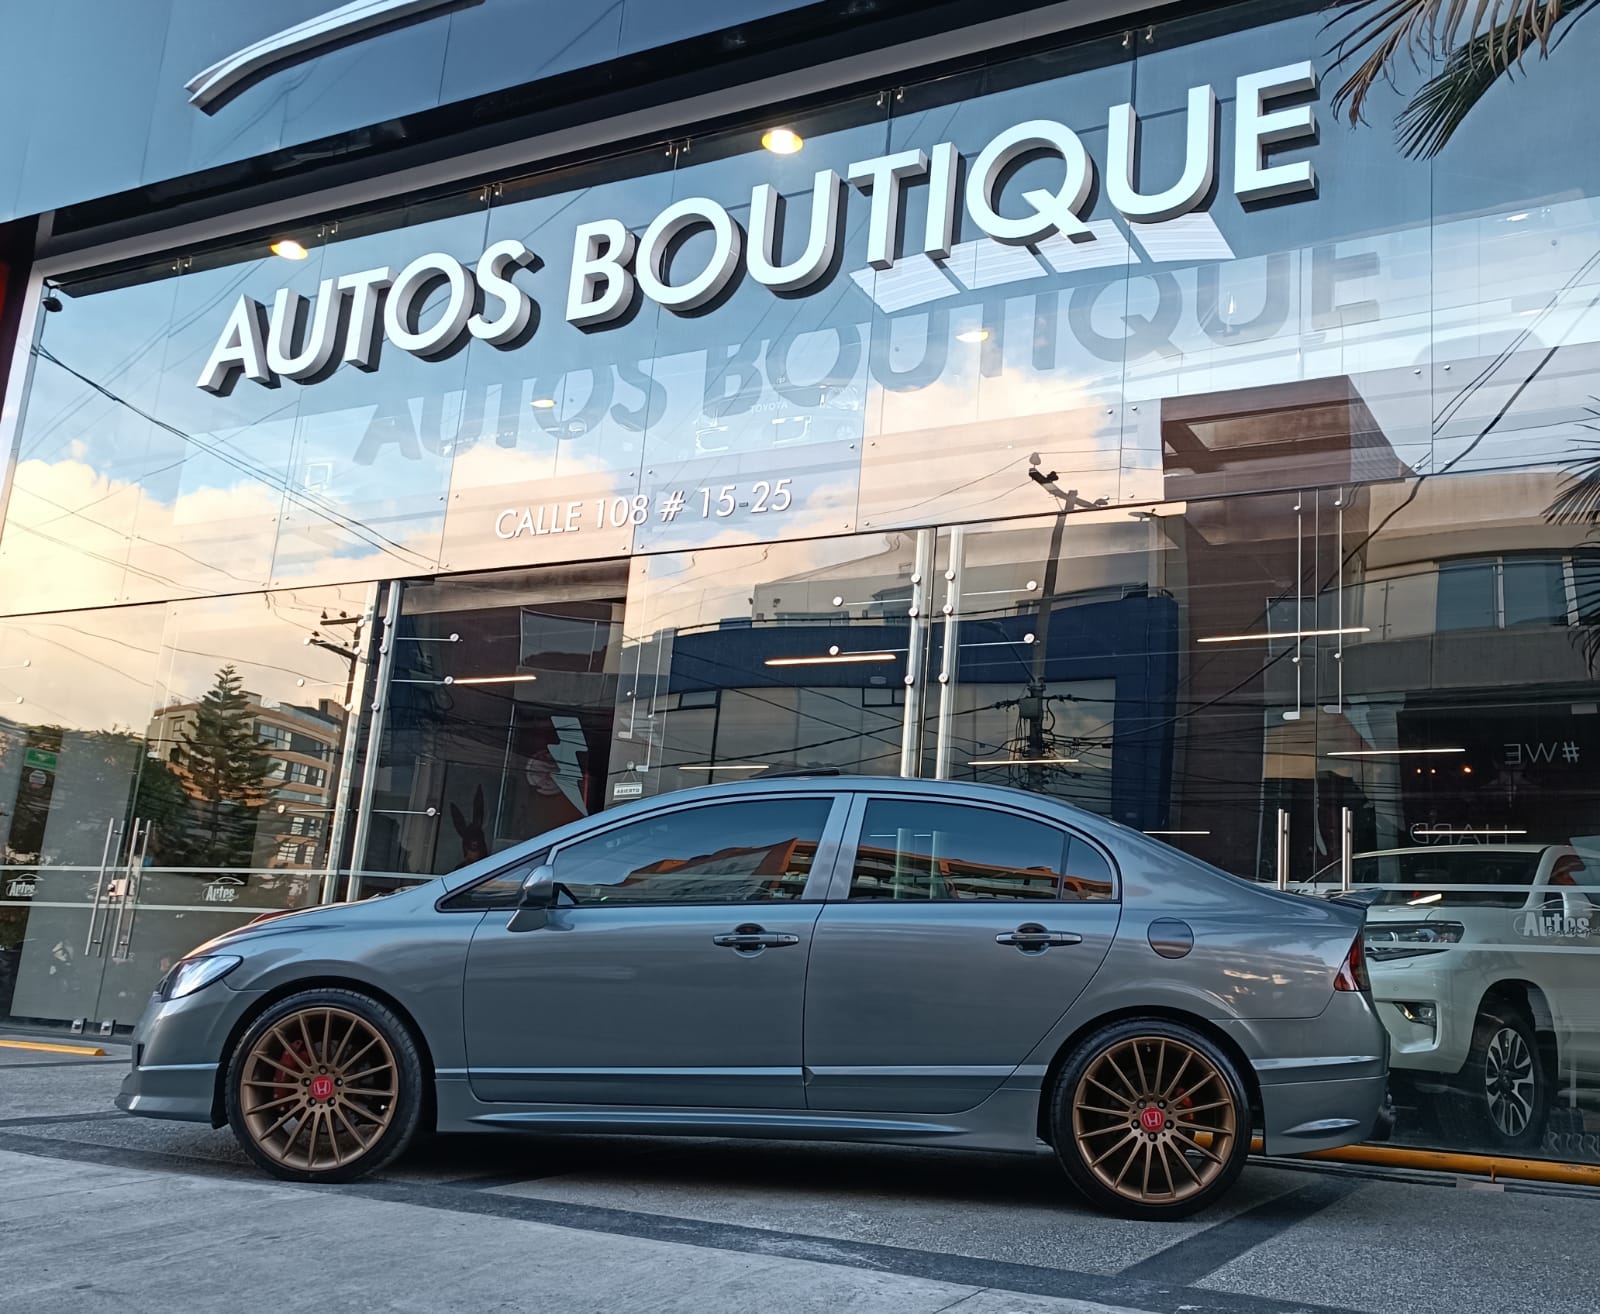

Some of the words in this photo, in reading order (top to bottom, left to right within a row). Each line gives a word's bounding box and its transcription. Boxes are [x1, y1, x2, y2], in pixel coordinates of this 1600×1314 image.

[197, 239, 543, 397] AUTOS
[565, 60, 1320, 333] BOUTIQUE
[751, 401, 789, 413] TOYOTA
[495, 501, 583, 540] CALLE
[595, 493, 650, 530] 108
[659, 489, 687, 523] #
[700, 478, 793, 518] 15-25
[1523, 911, 1590, 938] Autos
